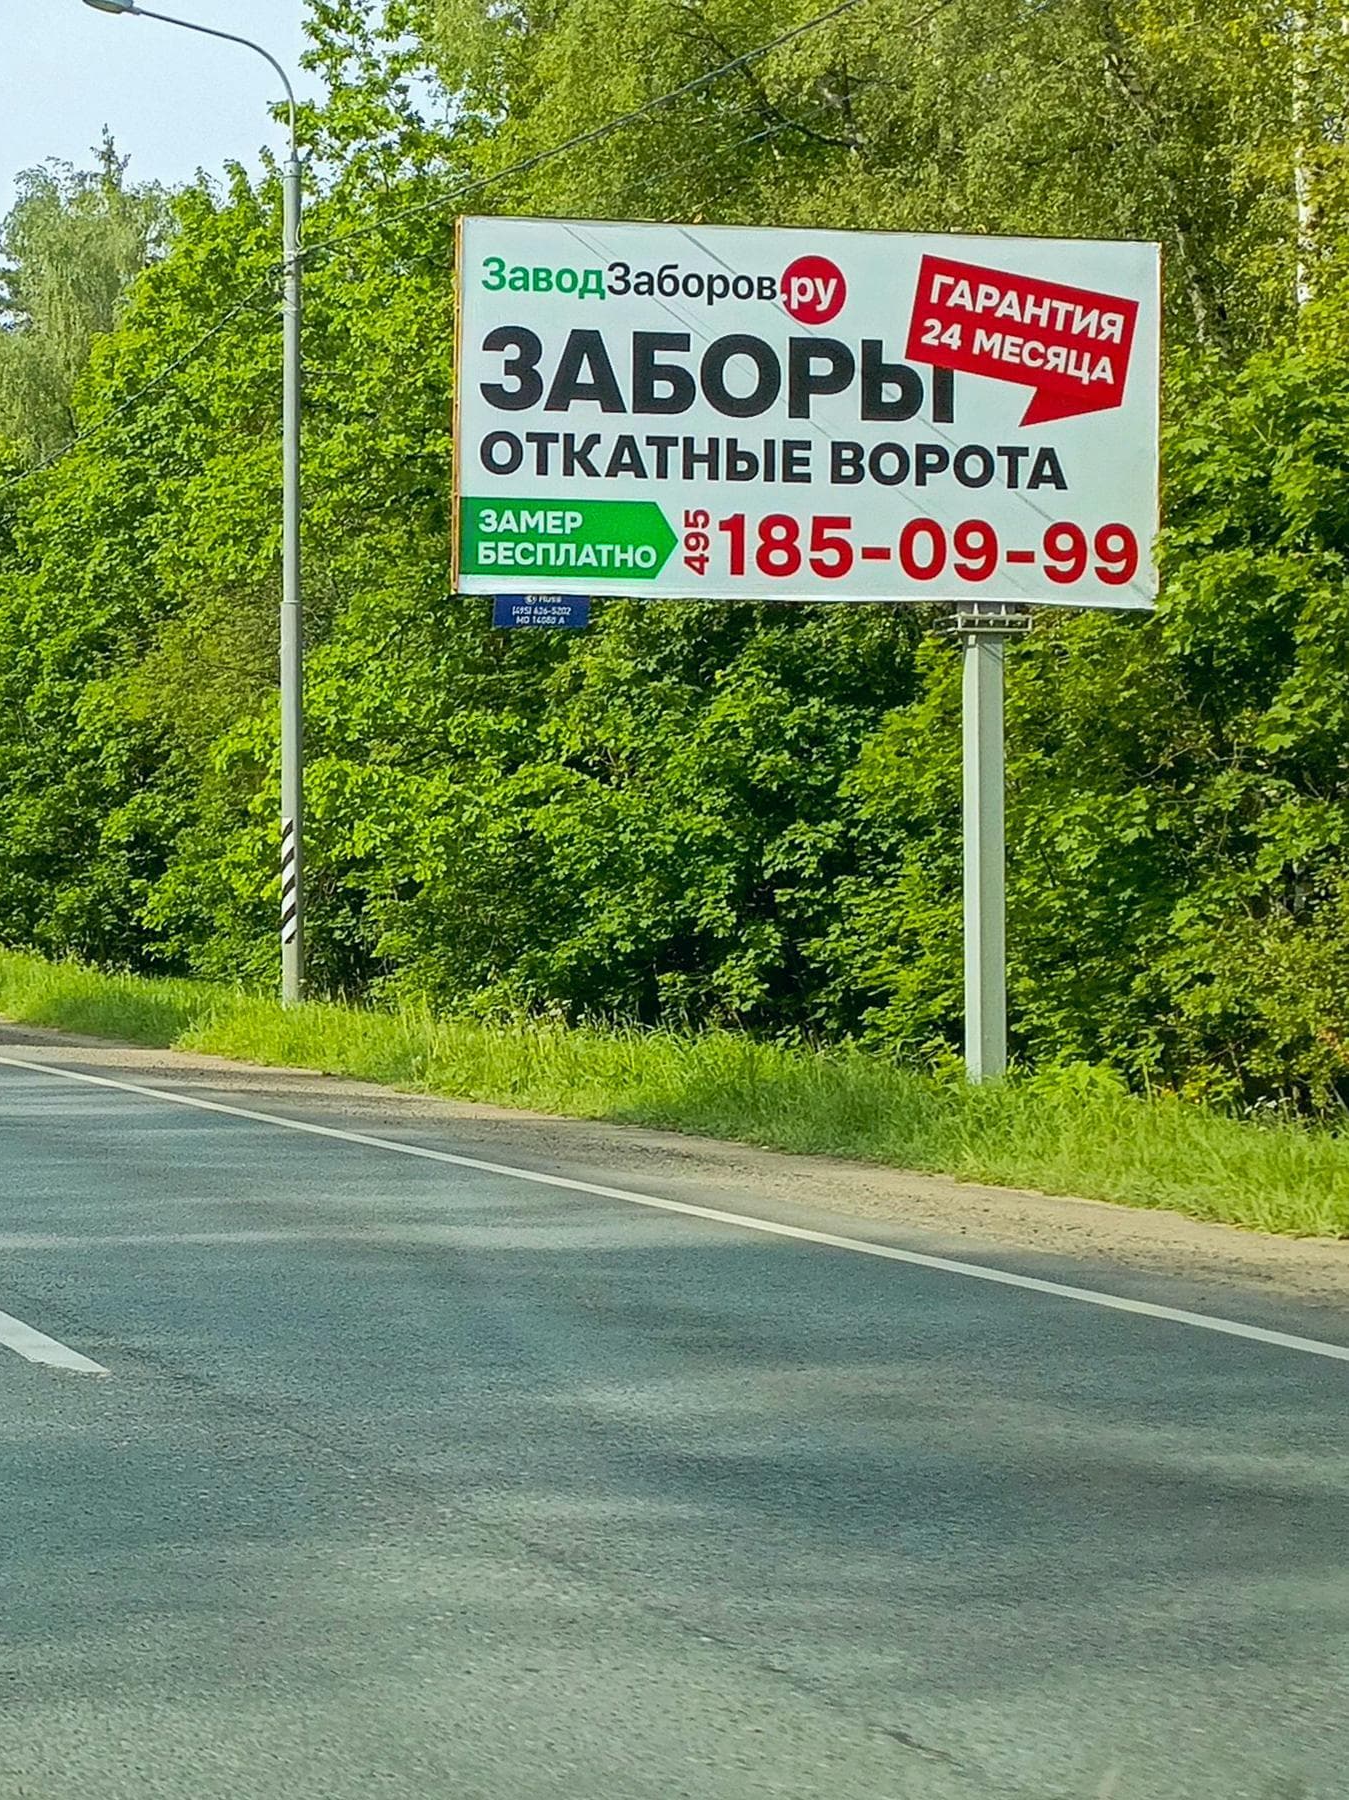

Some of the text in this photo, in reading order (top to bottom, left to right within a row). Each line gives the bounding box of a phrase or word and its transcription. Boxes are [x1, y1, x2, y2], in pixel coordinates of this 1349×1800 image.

[480, 256, 838, 312] ЗаводЗаборов.ру
[929, 273, 1125, 344] ГАРАНТИЯ
[479, 325, 955, 424] ЗАБОРЫ
[920, 318, 1116, 386] 24 МЕСЯЦА
[479, 430, 1069, 491] ОТКАТНЫЕ ВОРОТА
[477, 509, 584, 535] ЗАМЕР
[477, 541, 658, 569] БЕСПЛАТНО
[683, 508, 711, 577] 495
[718, 513, 1140, 586] 185-09-99
